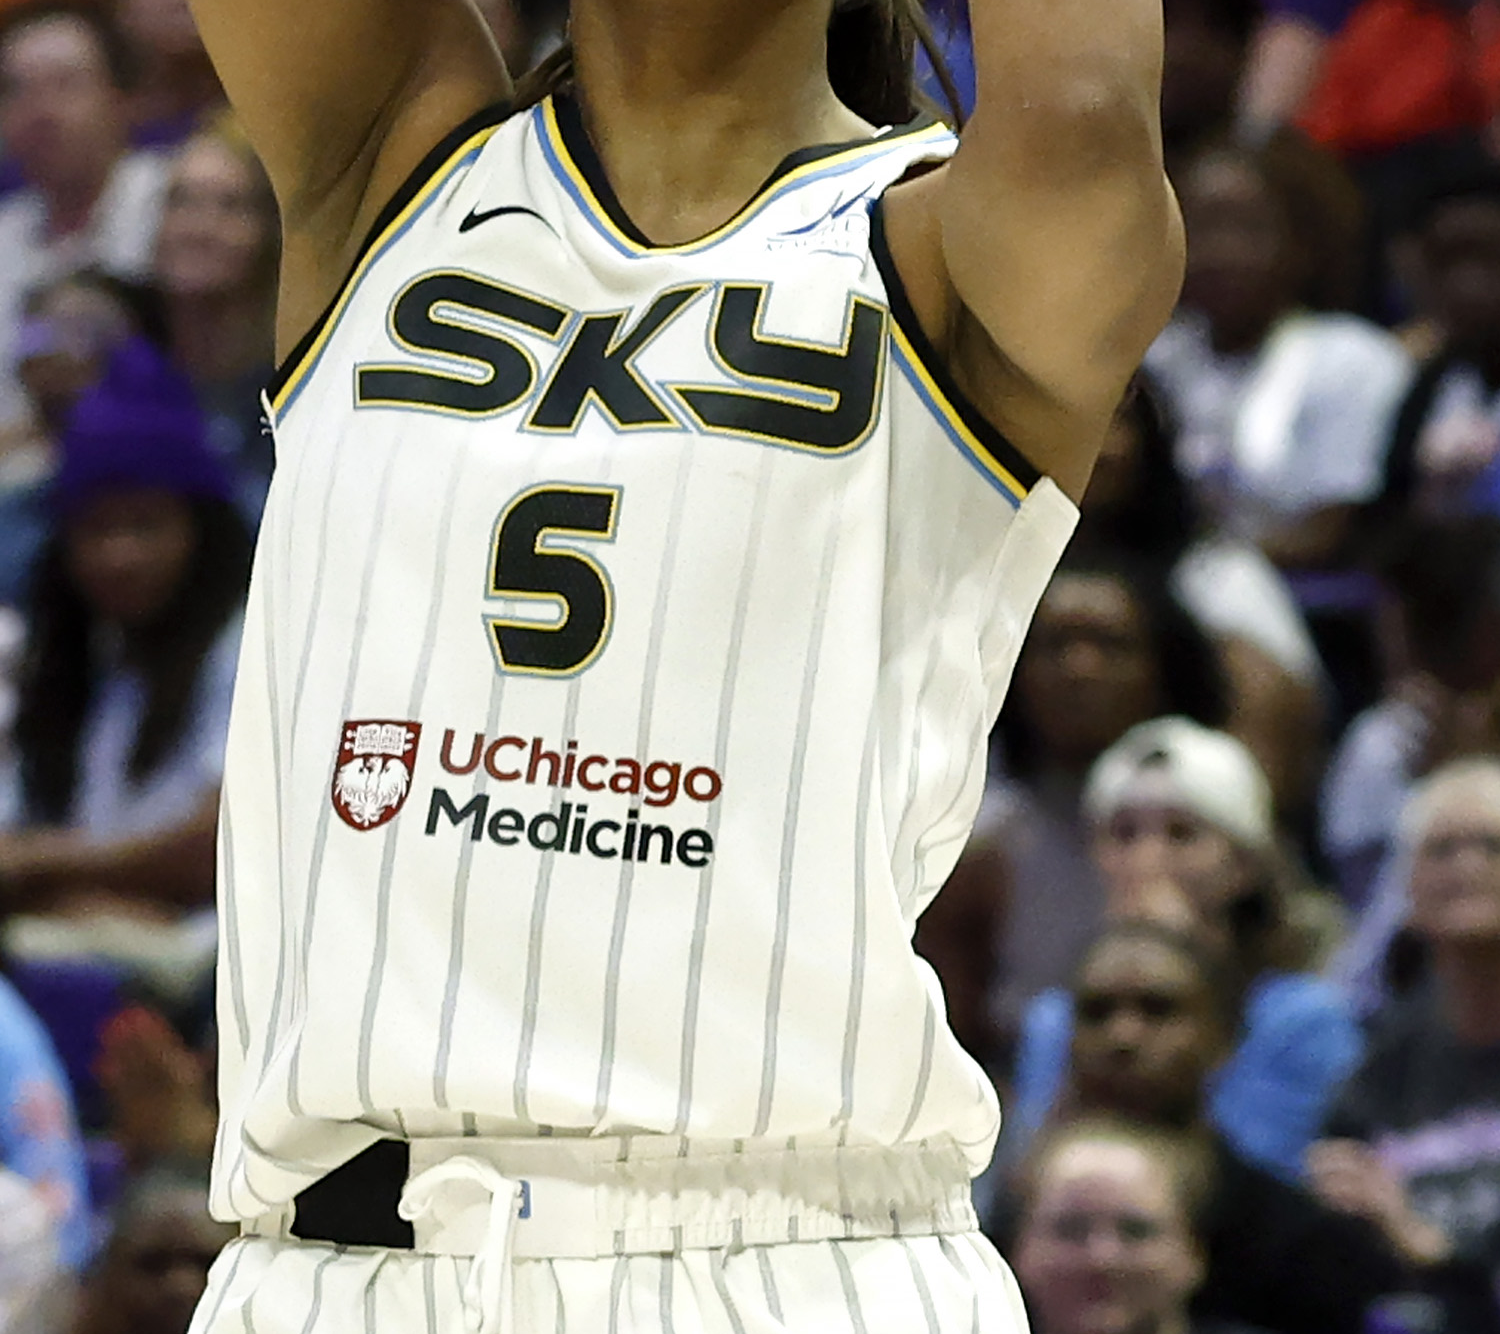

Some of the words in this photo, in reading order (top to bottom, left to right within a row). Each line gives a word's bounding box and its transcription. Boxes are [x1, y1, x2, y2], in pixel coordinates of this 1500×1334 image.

[354, 266, 890, 458] SKY
[481, 482, 624, 680] 5
[424, 786, 714, 868] Medicine
[439, 728, 722, 807] UChicago
